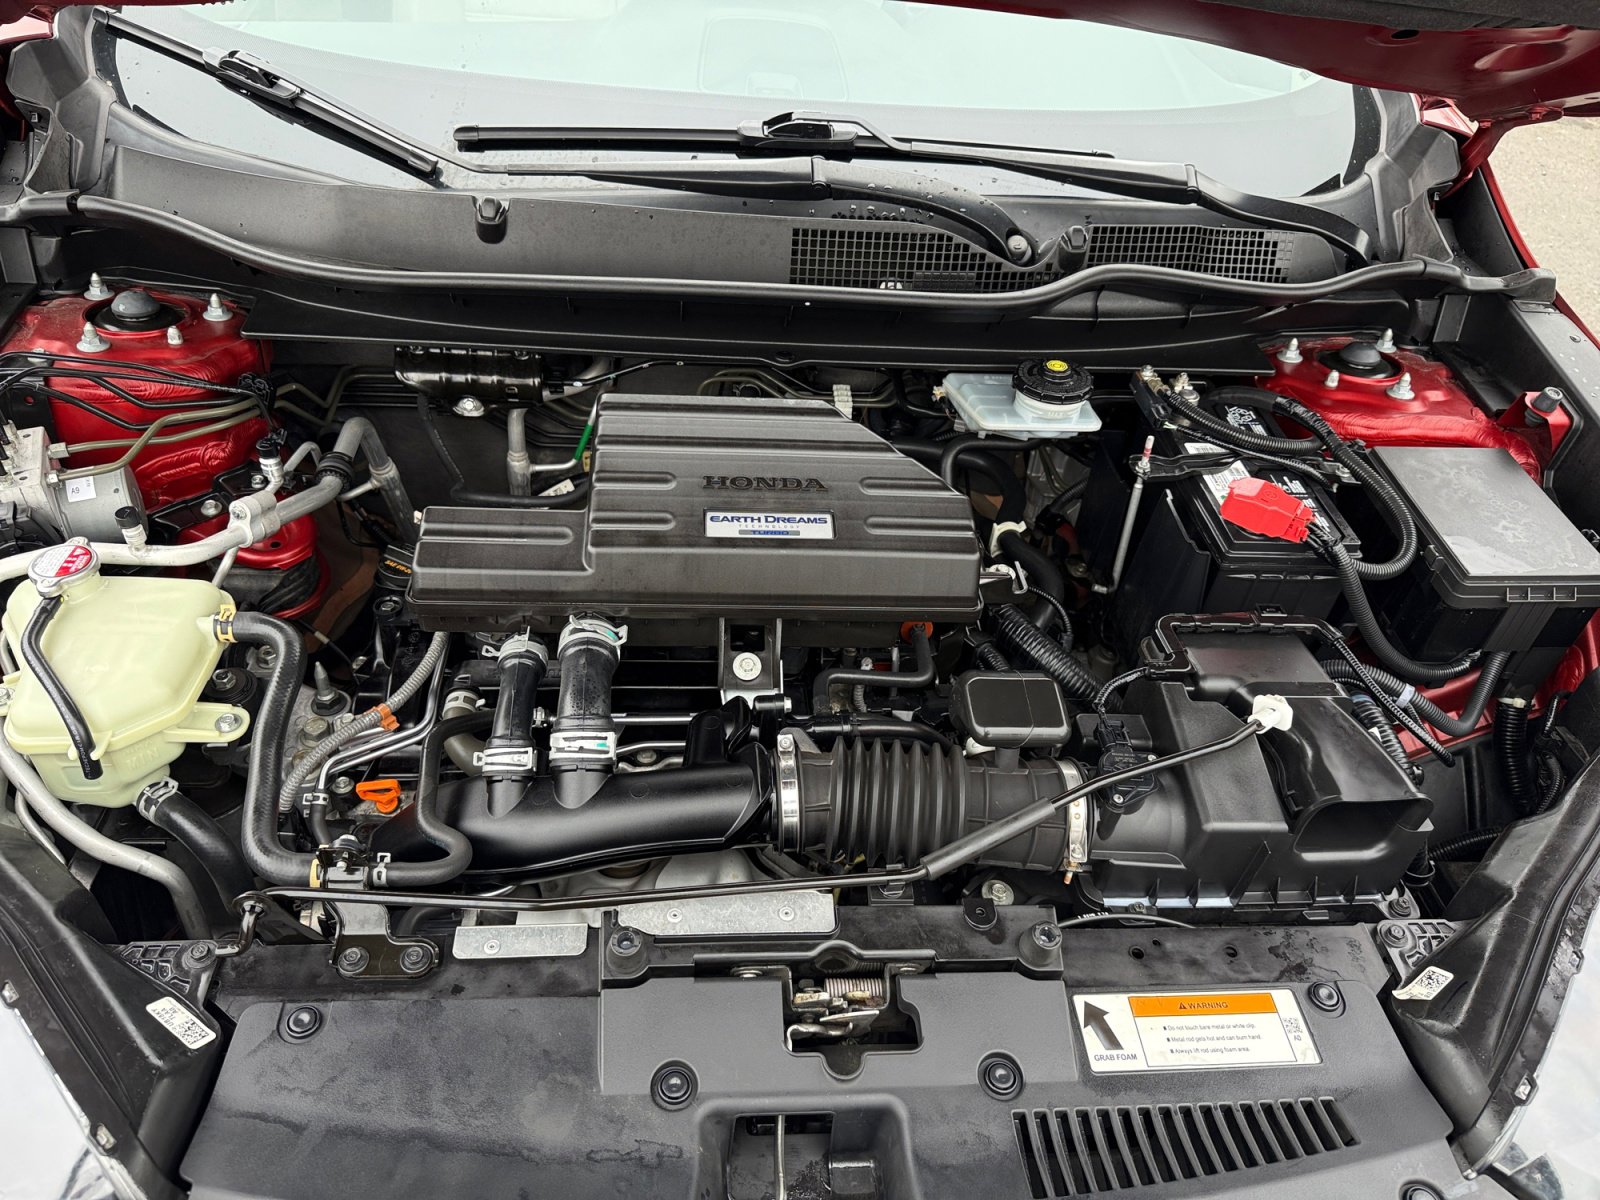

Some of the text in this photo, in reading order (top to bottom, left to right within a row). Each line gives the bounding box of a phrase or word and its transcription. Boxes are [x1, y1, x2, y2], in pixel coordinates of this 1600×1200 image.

[702, 475, 829, 492] HONDA
[709, 515, 828, 524] EARTH DREAMS
[1188, 1001, 1229, 1010] WARNING
[1094, 1053, 1138, 1062] GRAB FOAM
